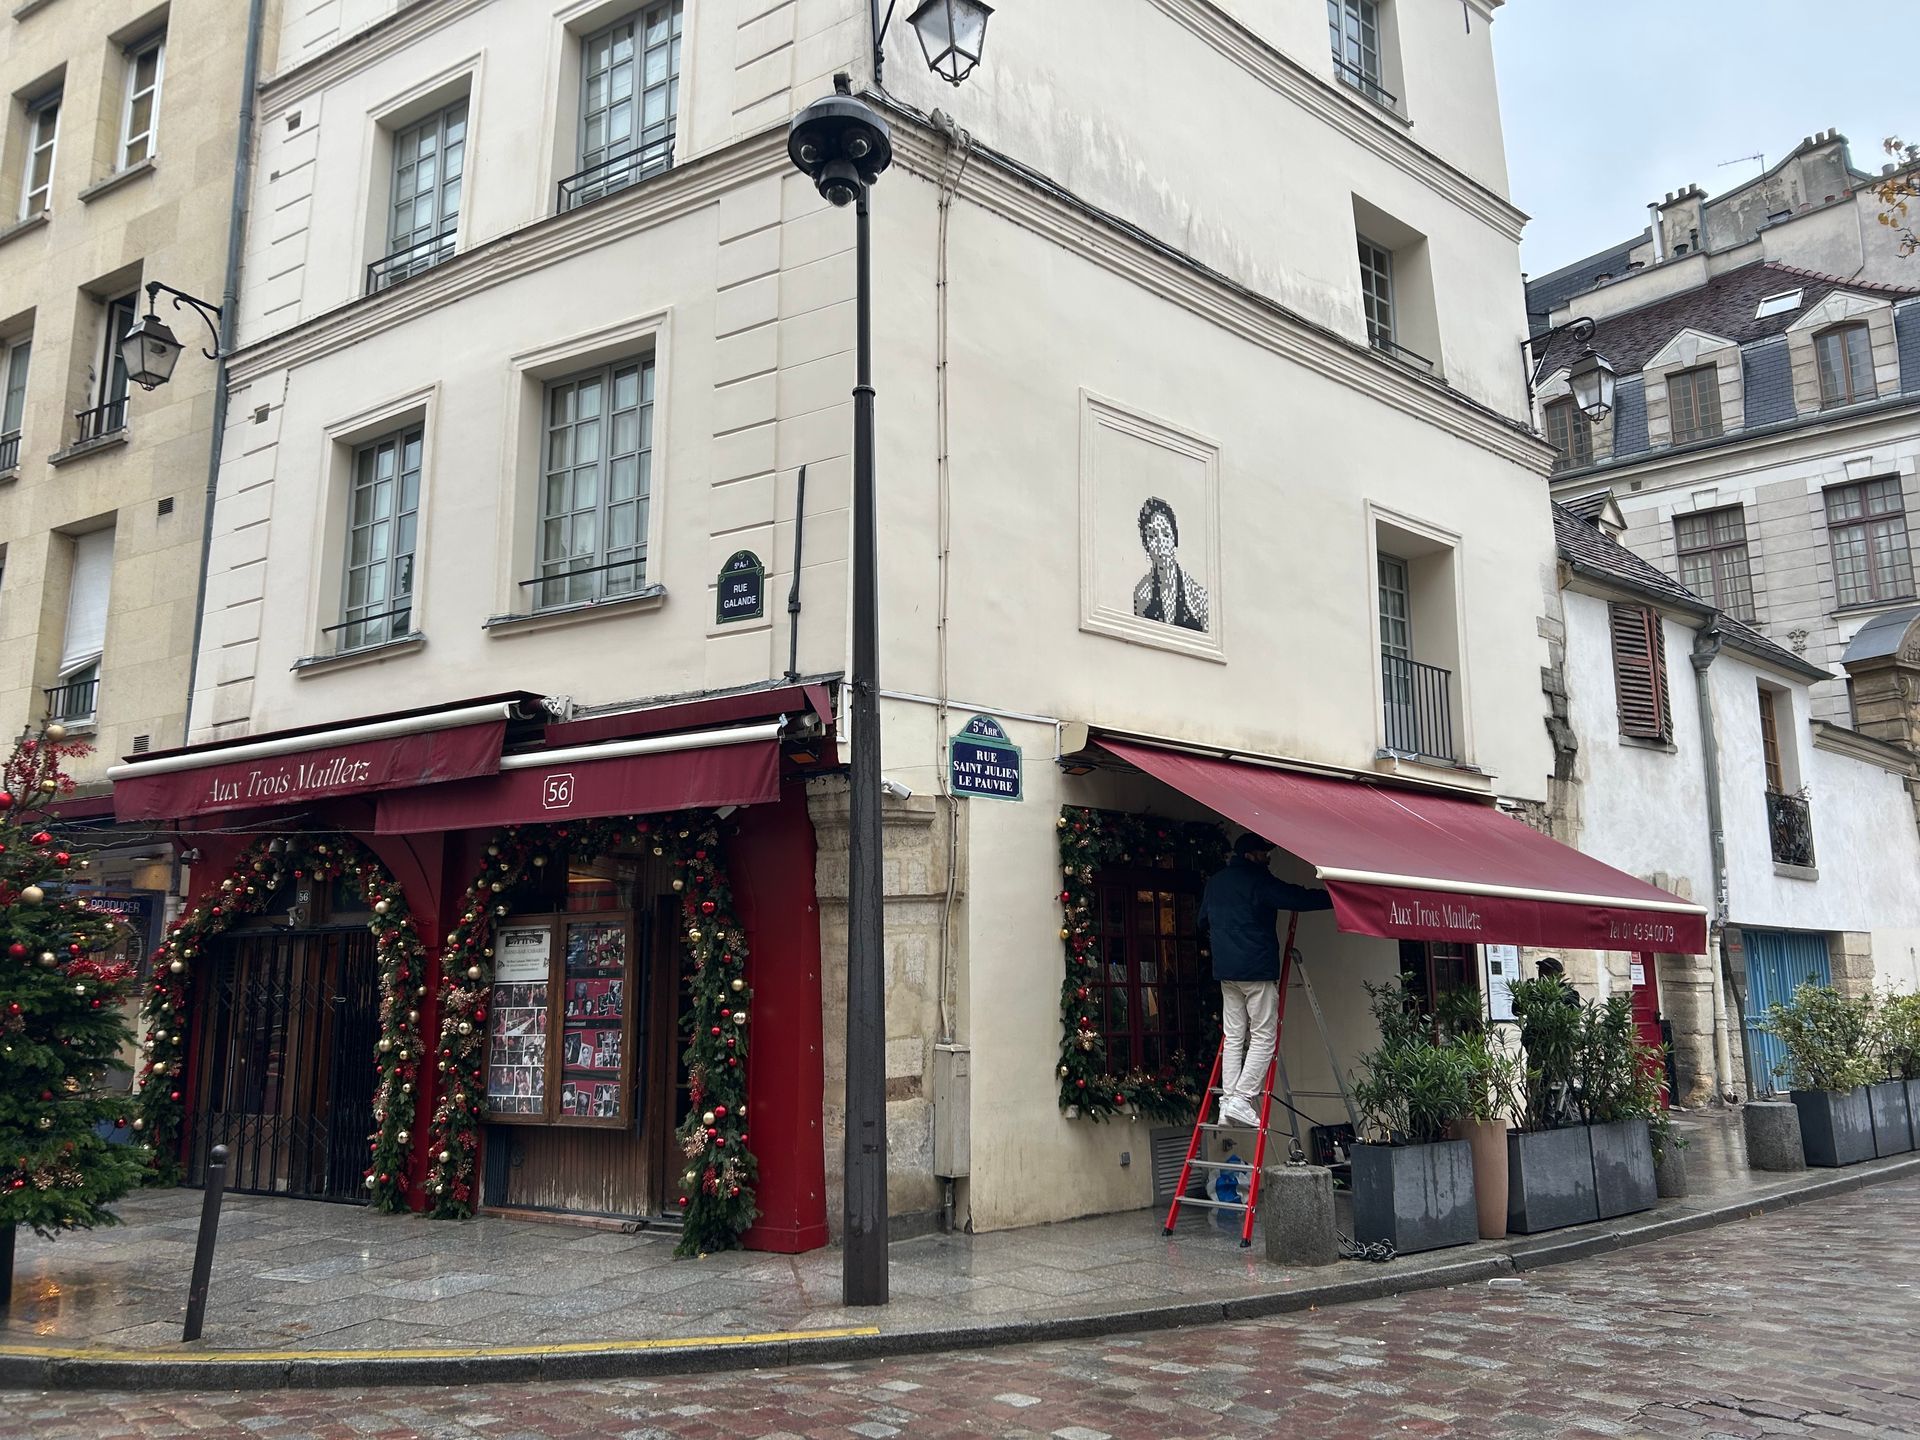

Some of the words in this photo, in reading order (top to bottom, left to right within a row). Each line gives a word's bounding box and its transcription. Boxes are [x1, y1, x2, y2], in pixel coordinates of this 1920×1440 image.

[733, 583, 748, 594] RUE
[724, 596, 757, 608] GALANDE
[976, 750, 998, 763] RUE
[953, 761, 982, 774] SAINT
[985, 766, 1019, 779] JULIEN
[205, 777, 242, 803] Aux
[247, 767, 291, 798] Trois
[292, 756, 372, 792] Mailletz
[958, 774, 972, 787] LE
[975, 778, 1013, 791] PAUVRE
[547, 780, 569, 802] 56
[298, 891, 309, 902] 56
[1388, 900, 1413, 926] Aux
[1413, 901, 1440, 928] Trois
[1442, 903, 1482, 931] Mailletz
[1633, 923, 1643, 941] 43
[1644, 923, 1654, 941] 54
[1665, 925, 1674, 943] 79
